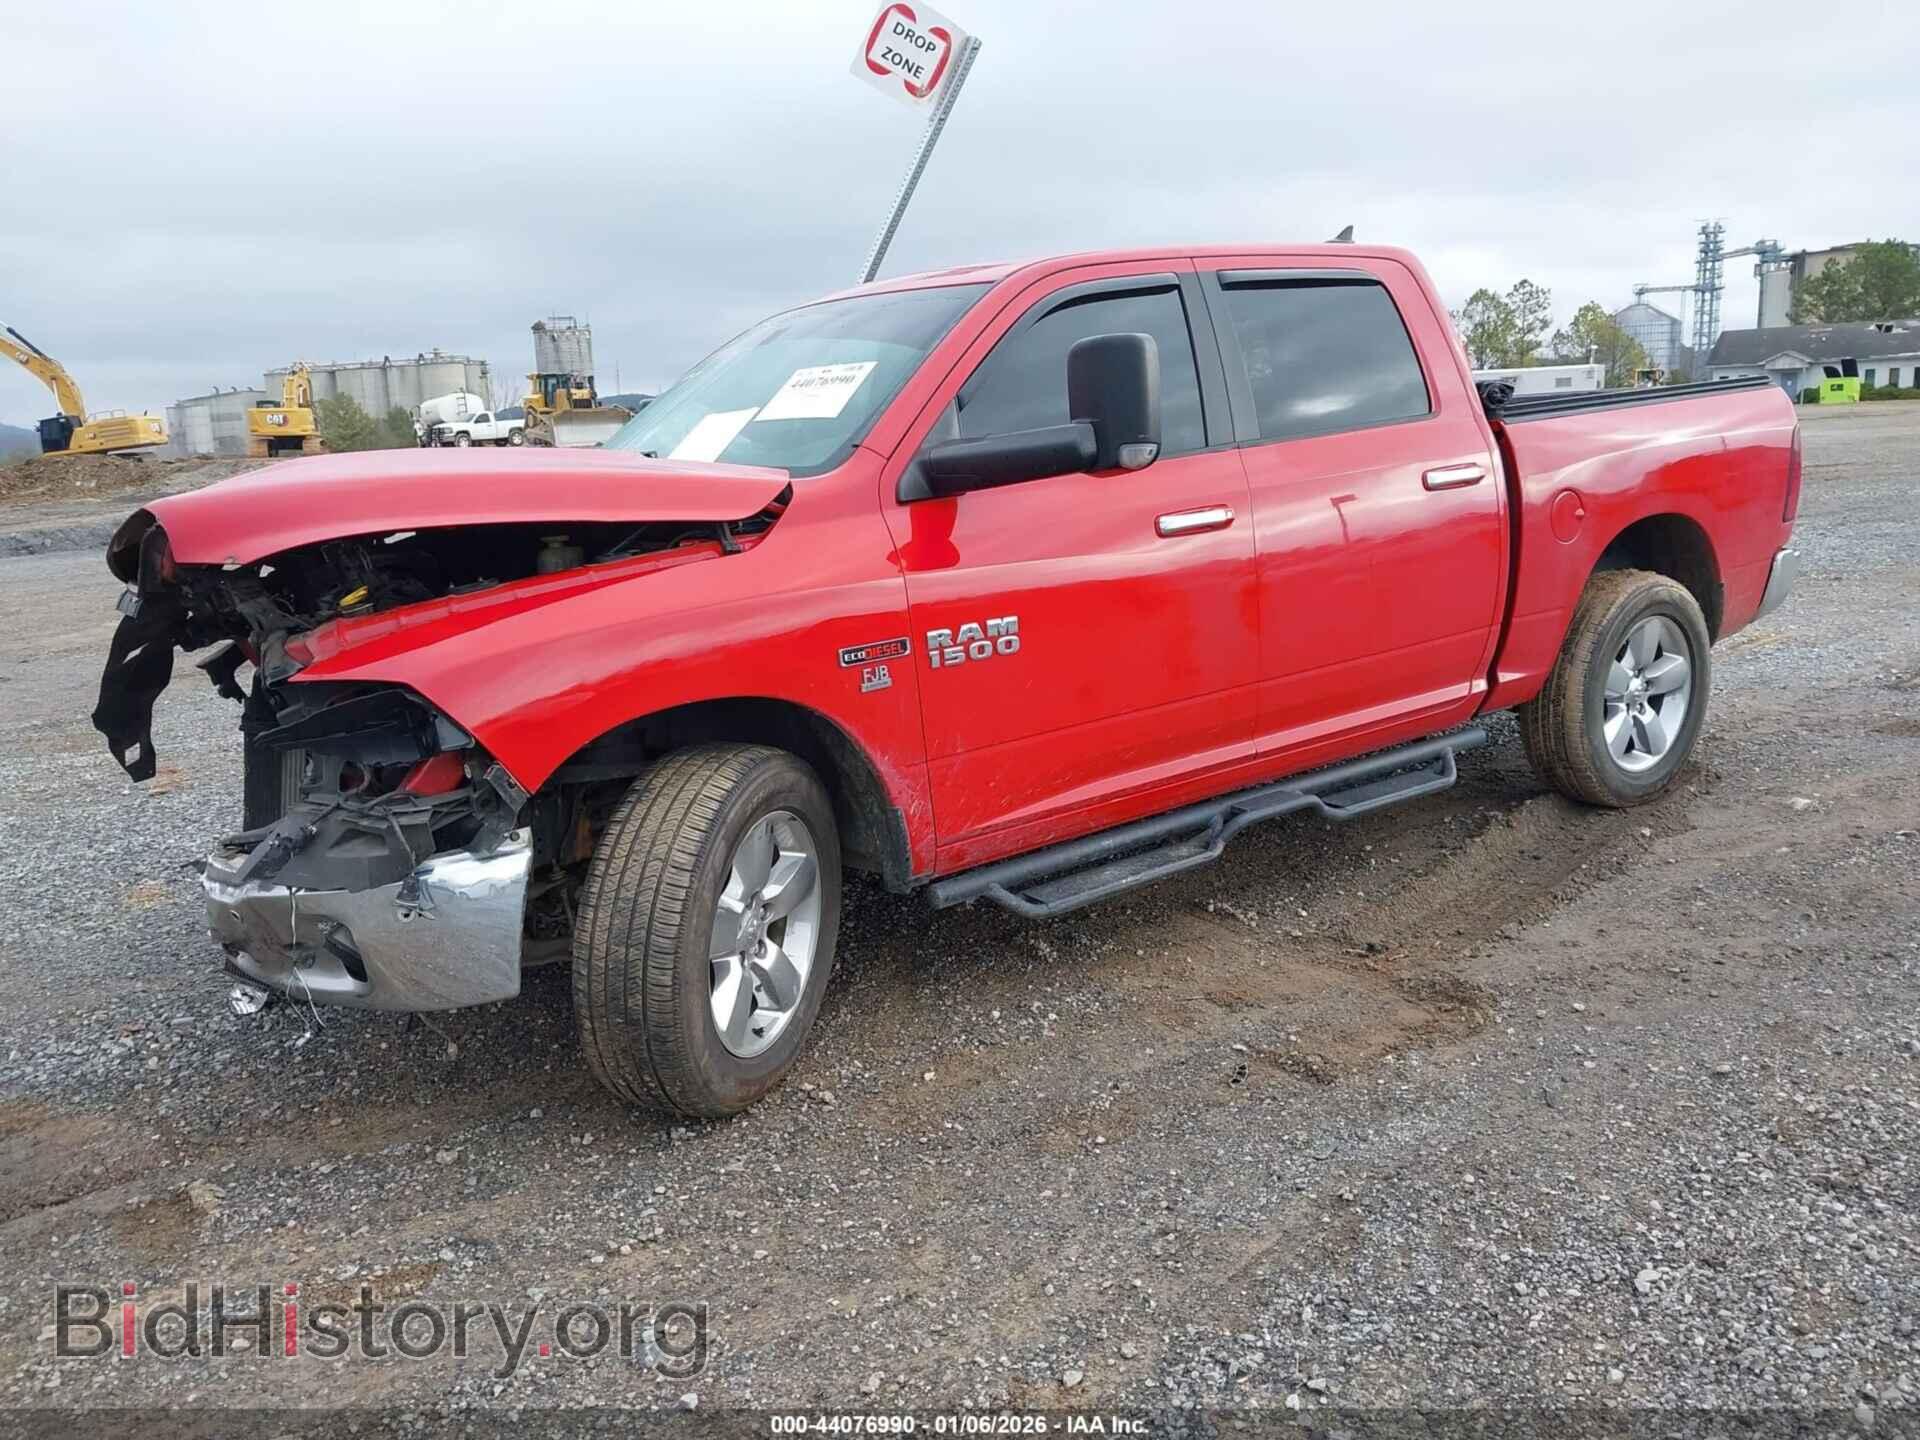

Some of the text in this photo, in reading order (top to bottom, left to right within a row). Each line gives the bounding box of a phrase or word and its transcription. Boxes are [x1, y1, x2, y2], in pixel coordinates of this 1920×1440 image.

[893, 22, 936, 53] DROP
[881, 46, 925, 79] ZONE
[926, 616, 1019, 650] RAM
[930, 635, 1021, 669] 1500
